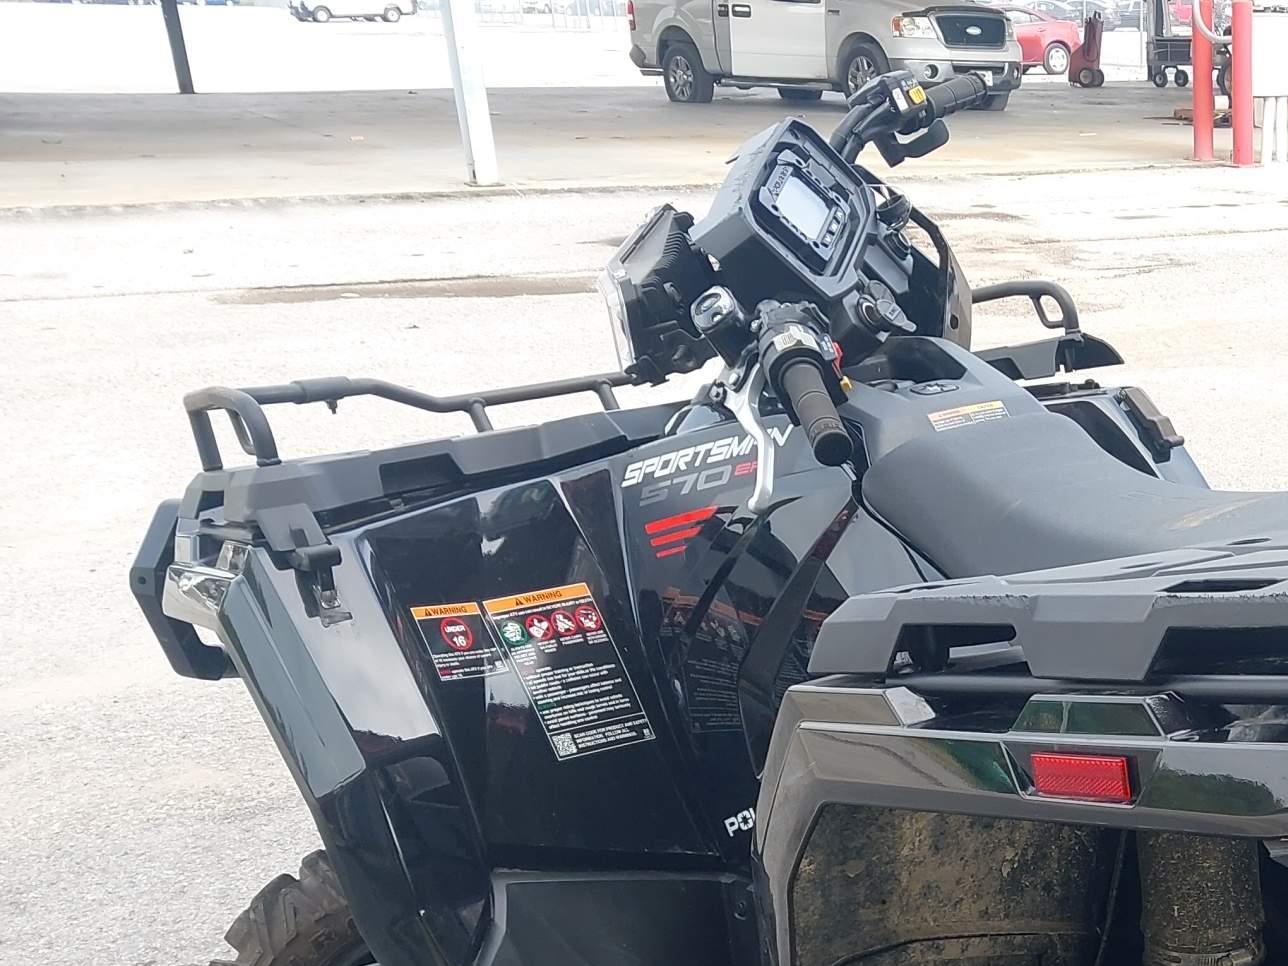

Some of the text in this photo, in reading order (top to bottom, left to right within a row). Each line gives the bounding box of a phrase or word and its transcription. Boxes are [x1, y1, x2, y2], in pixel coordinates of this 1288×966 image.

[640, 460, 758, 507] 570 EP
[524, 590, 563, 603] WARNING
[431, 606, 467, 616] WARNING
[444, 624, 466, 633] UNDER
[452, 635, 467, 647] 16
